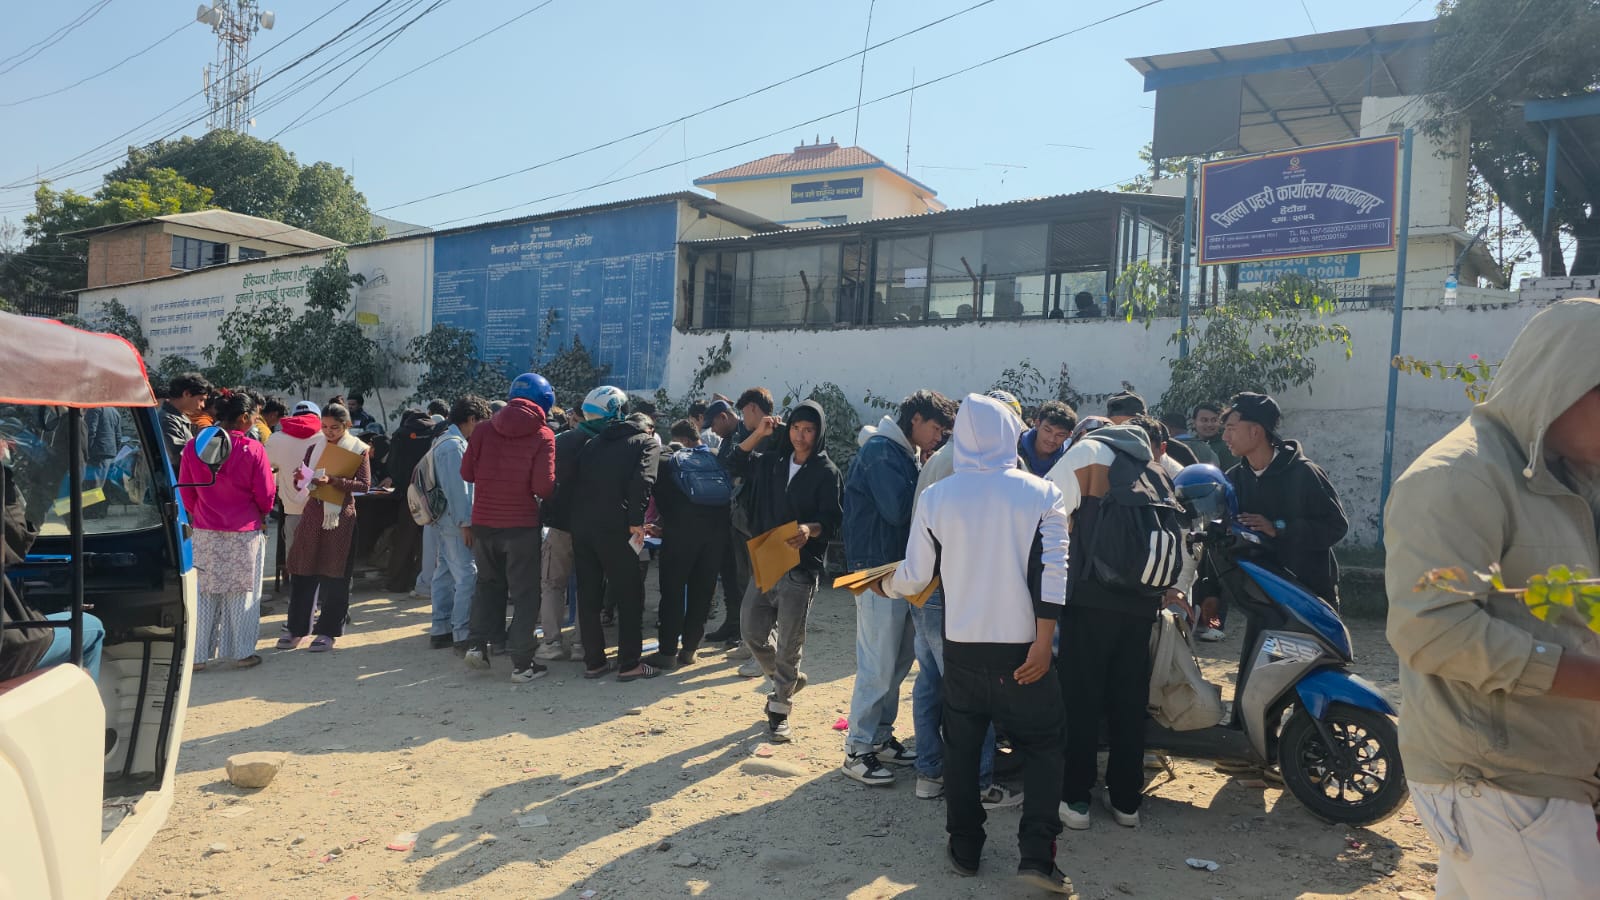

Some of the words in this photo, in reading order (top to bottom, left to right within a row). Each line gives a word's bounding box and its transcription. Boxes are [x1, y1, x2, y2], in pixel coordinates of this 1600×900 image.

[1210, 201, 1250, 229] जिल्ला
[1246, 185, 1275, 212] प्रहरी
[1276, 178, 1328, 201] कार्यालय
[1326, 183, 1385, 214] मकवानपुर
[1306, 265, 1345, 277] ROOM
